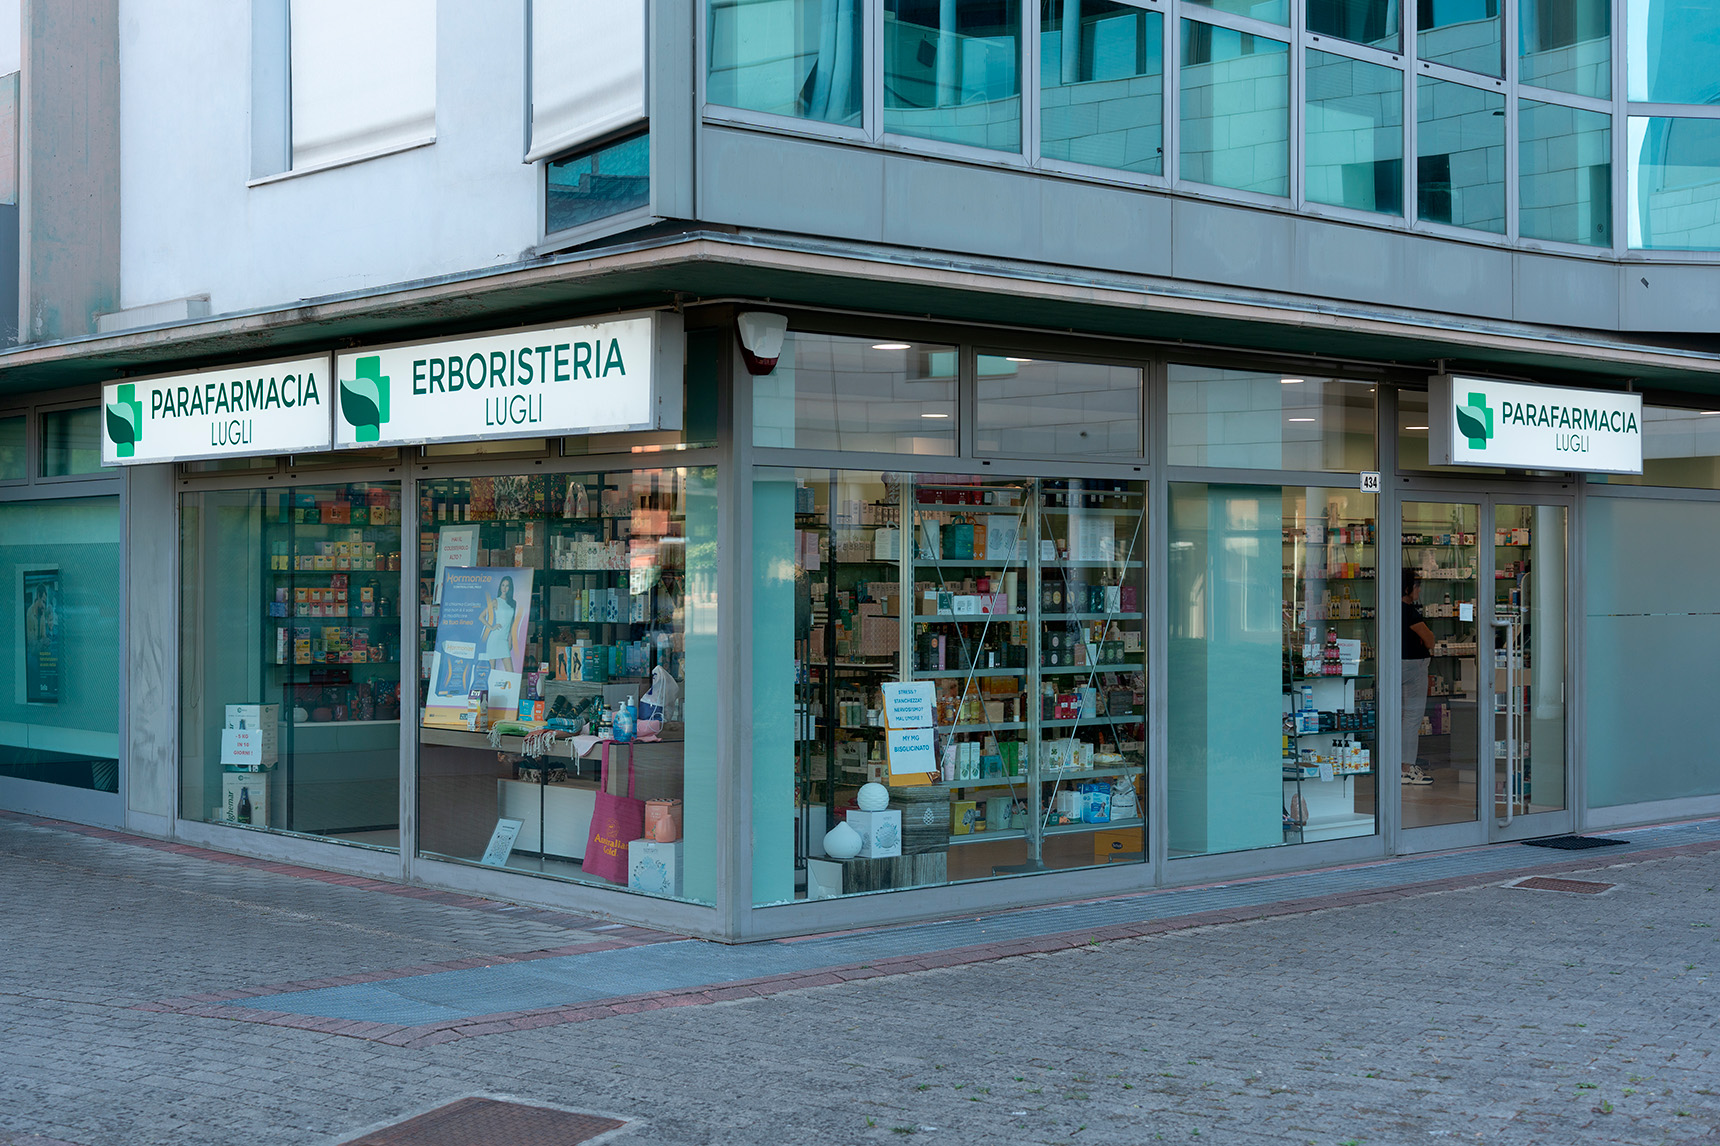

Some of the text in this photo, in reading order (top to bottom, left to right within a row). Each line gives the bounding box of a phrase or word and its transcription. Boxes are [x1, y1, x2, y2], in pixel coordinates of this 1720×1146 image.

[413, 338, 626, 395] ERBORISTERIA
[151, 372, 320, 419] PARAFARMACIA
[486, 393, 542, 426] LUGLI
[211, 419, 252, 446] LUGLI
[1502, 401, 1638, 434] PARAFARMACIA
[1555, 433, 1590, 453] LUGLI
[1363, 476, 1378, 489] 434
